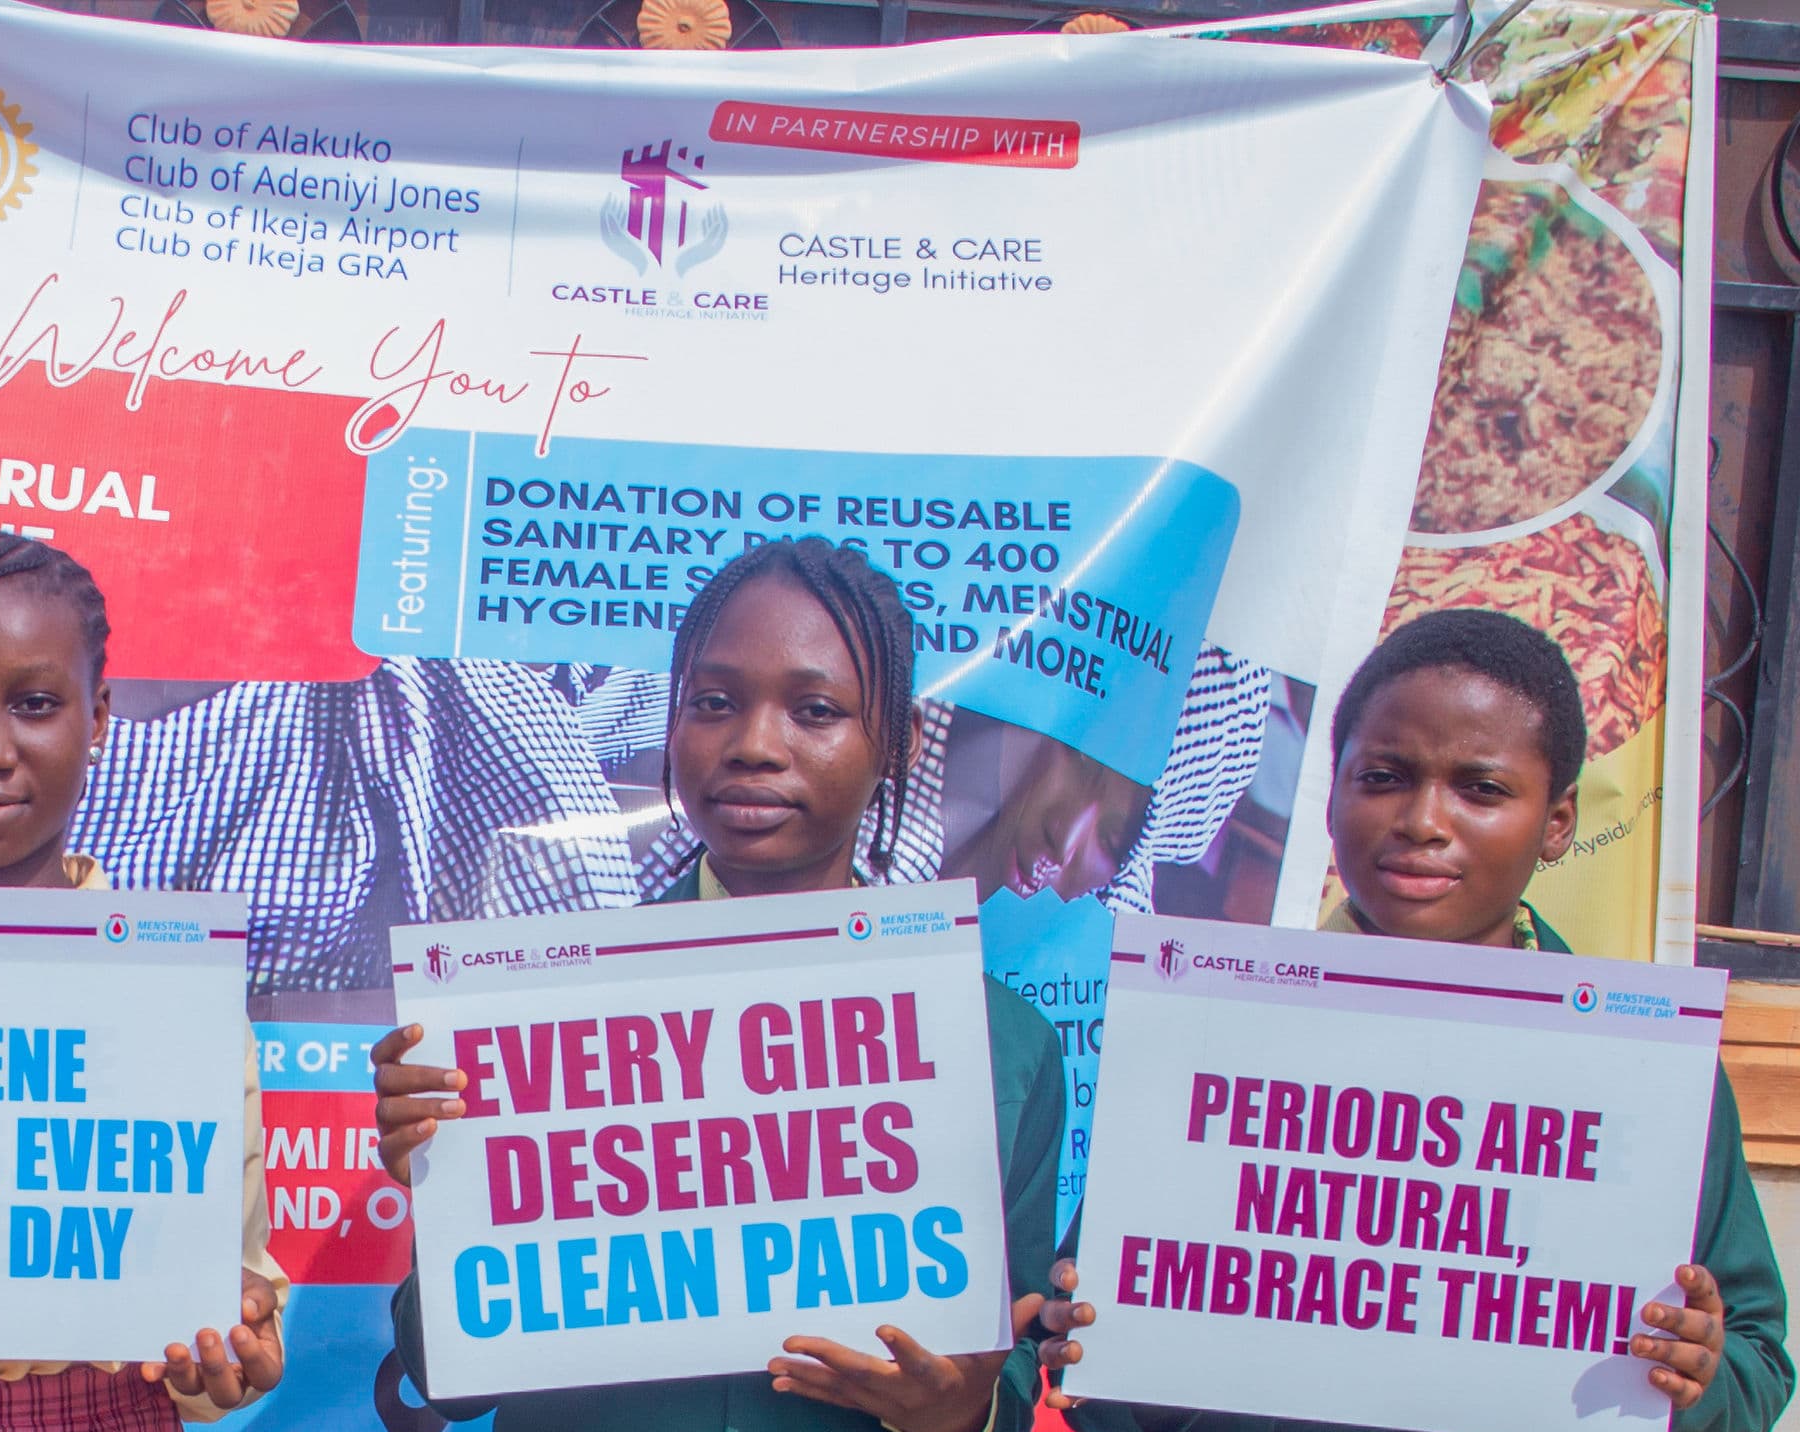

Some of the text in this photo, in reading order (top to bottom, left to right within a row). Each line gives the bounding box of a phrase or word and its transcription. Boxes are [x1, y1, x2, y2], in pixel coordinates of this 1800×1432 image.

[127, 112, 392, 163] Club of Alakuko
[725, 112, 1066, 161] IN PARTNERSHIP WITH
[124, 154, 481, 215] Club of Adeniyi Jones
[116, 225, 408, 281] Club of Ikeja GRA
[120, 194, 459, 254] Club of Ikeja Airport
[778, 231, 1042, 263] CASTLE & CARE
[551, 284, 657, 306] CASTLE
[694, 293, 769, 311] CARE
[778, 263, 1053, 294] Heritage Initiative
[348, 317, 529, 453] You
[530, 334, 648, 457] to
[486, 477, 1071, 532] DONATION OF REUSABLE
[381, 455, 448, 634] Featuring:
[482, 518, 727, 556] SANITARY
[883, 538, 951, 570] TO
[964, 543, 1060, 573] 400
[480, 557, 669, 592] FEMALE
[963, 583, 1175, 675] MENSTRUAL
[913, 623, 979, 654] ND
[993, 626, 1107, 699] MORE.
[462, 949, 525, 967] CASTLE
[546, 944, 591, 959] CARE
[1192, 955, 1255, 973] CASTLE
[1275, 963, 1319, 979] CARE
[296, 1041, 348, 1073] OF
[453, 991, 936, 1121] EVERY GIRL
[16, 1117, 217, 1194] EVERY
[1187, 1071, 1602, 1182] PERIODS ARE
[485, 1101, 919, 1226] DESERVES
[9, 1205, 133, 1280] DAY
[1234, 1162, 1530, 1268] NATURAL,
[454, 1206, 969, 1339] CLEAN PADS
[1116, 1234, 1637, 1356] EMBRACE THEM!
